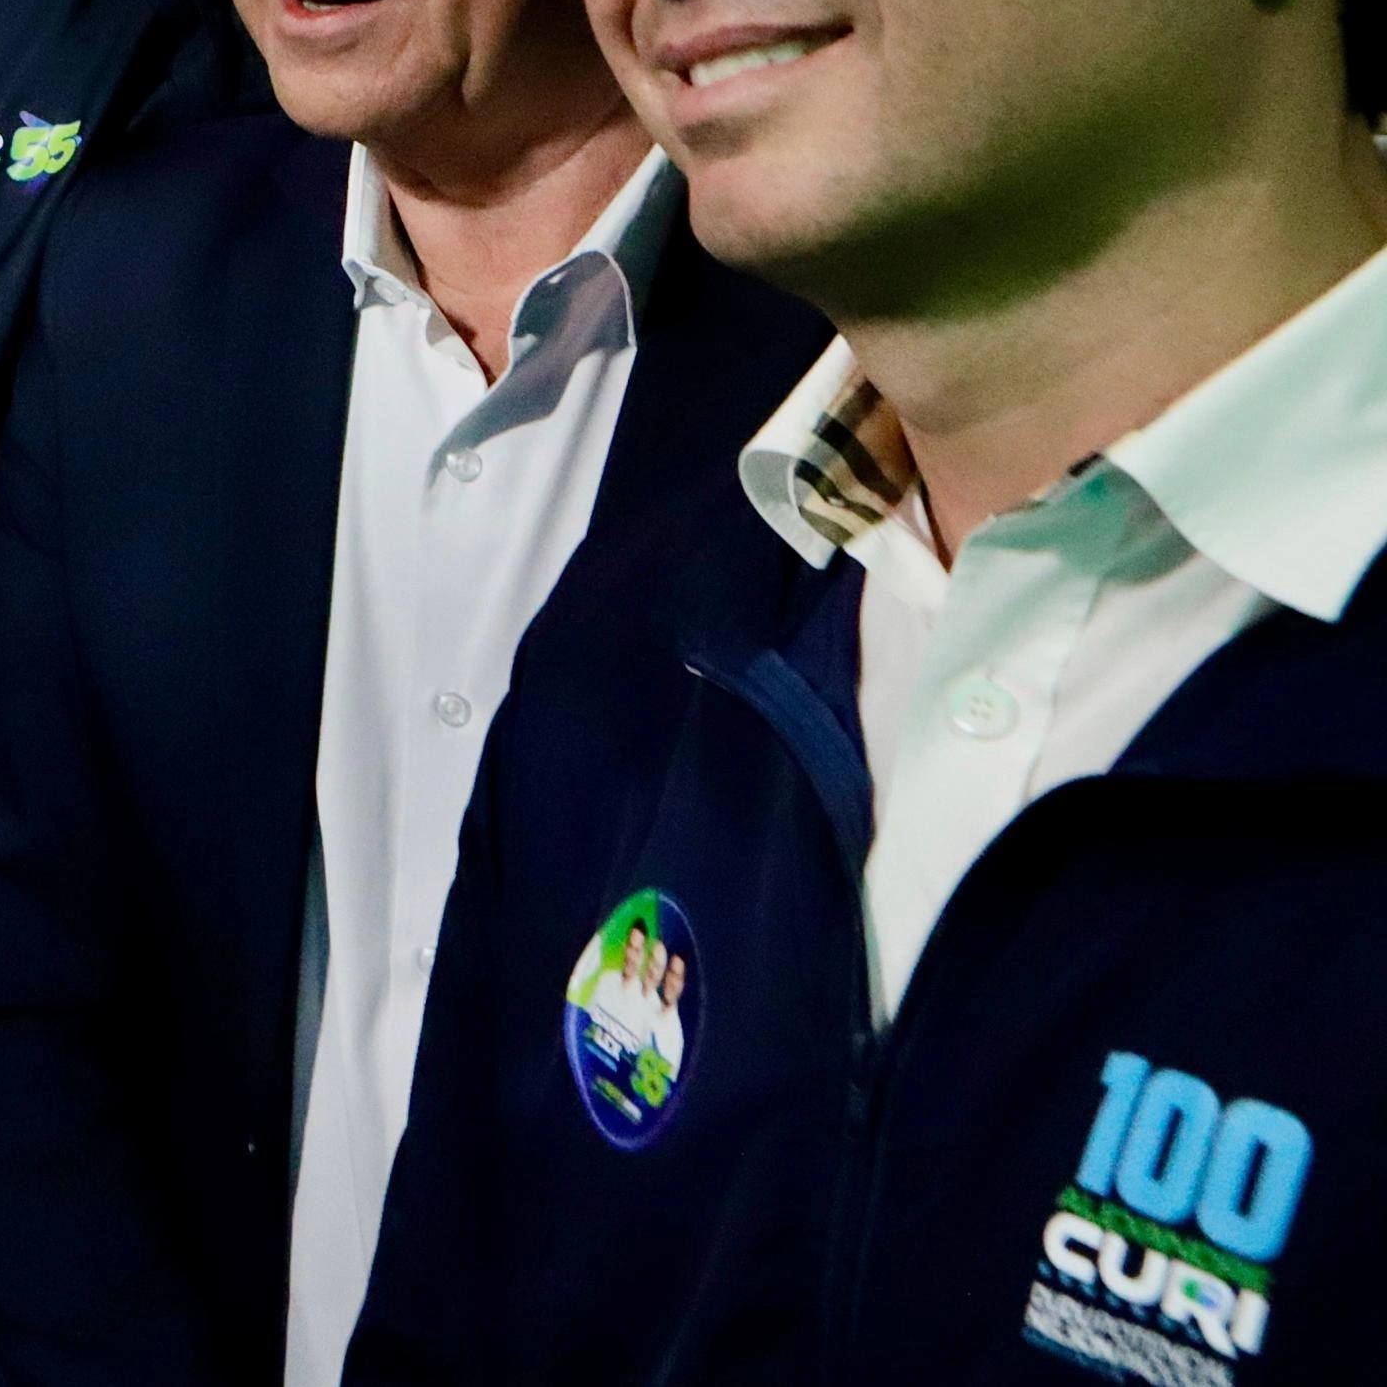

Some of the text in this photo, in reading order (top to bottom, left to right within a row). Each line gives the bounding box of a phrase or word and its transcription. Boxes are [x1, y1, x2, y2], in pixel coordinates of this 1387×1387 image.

[6, 120, 82, 181] 55
[1074, 1051, 1315, 1263] 100
[1043, 1211, 1270, 1360] CURI
